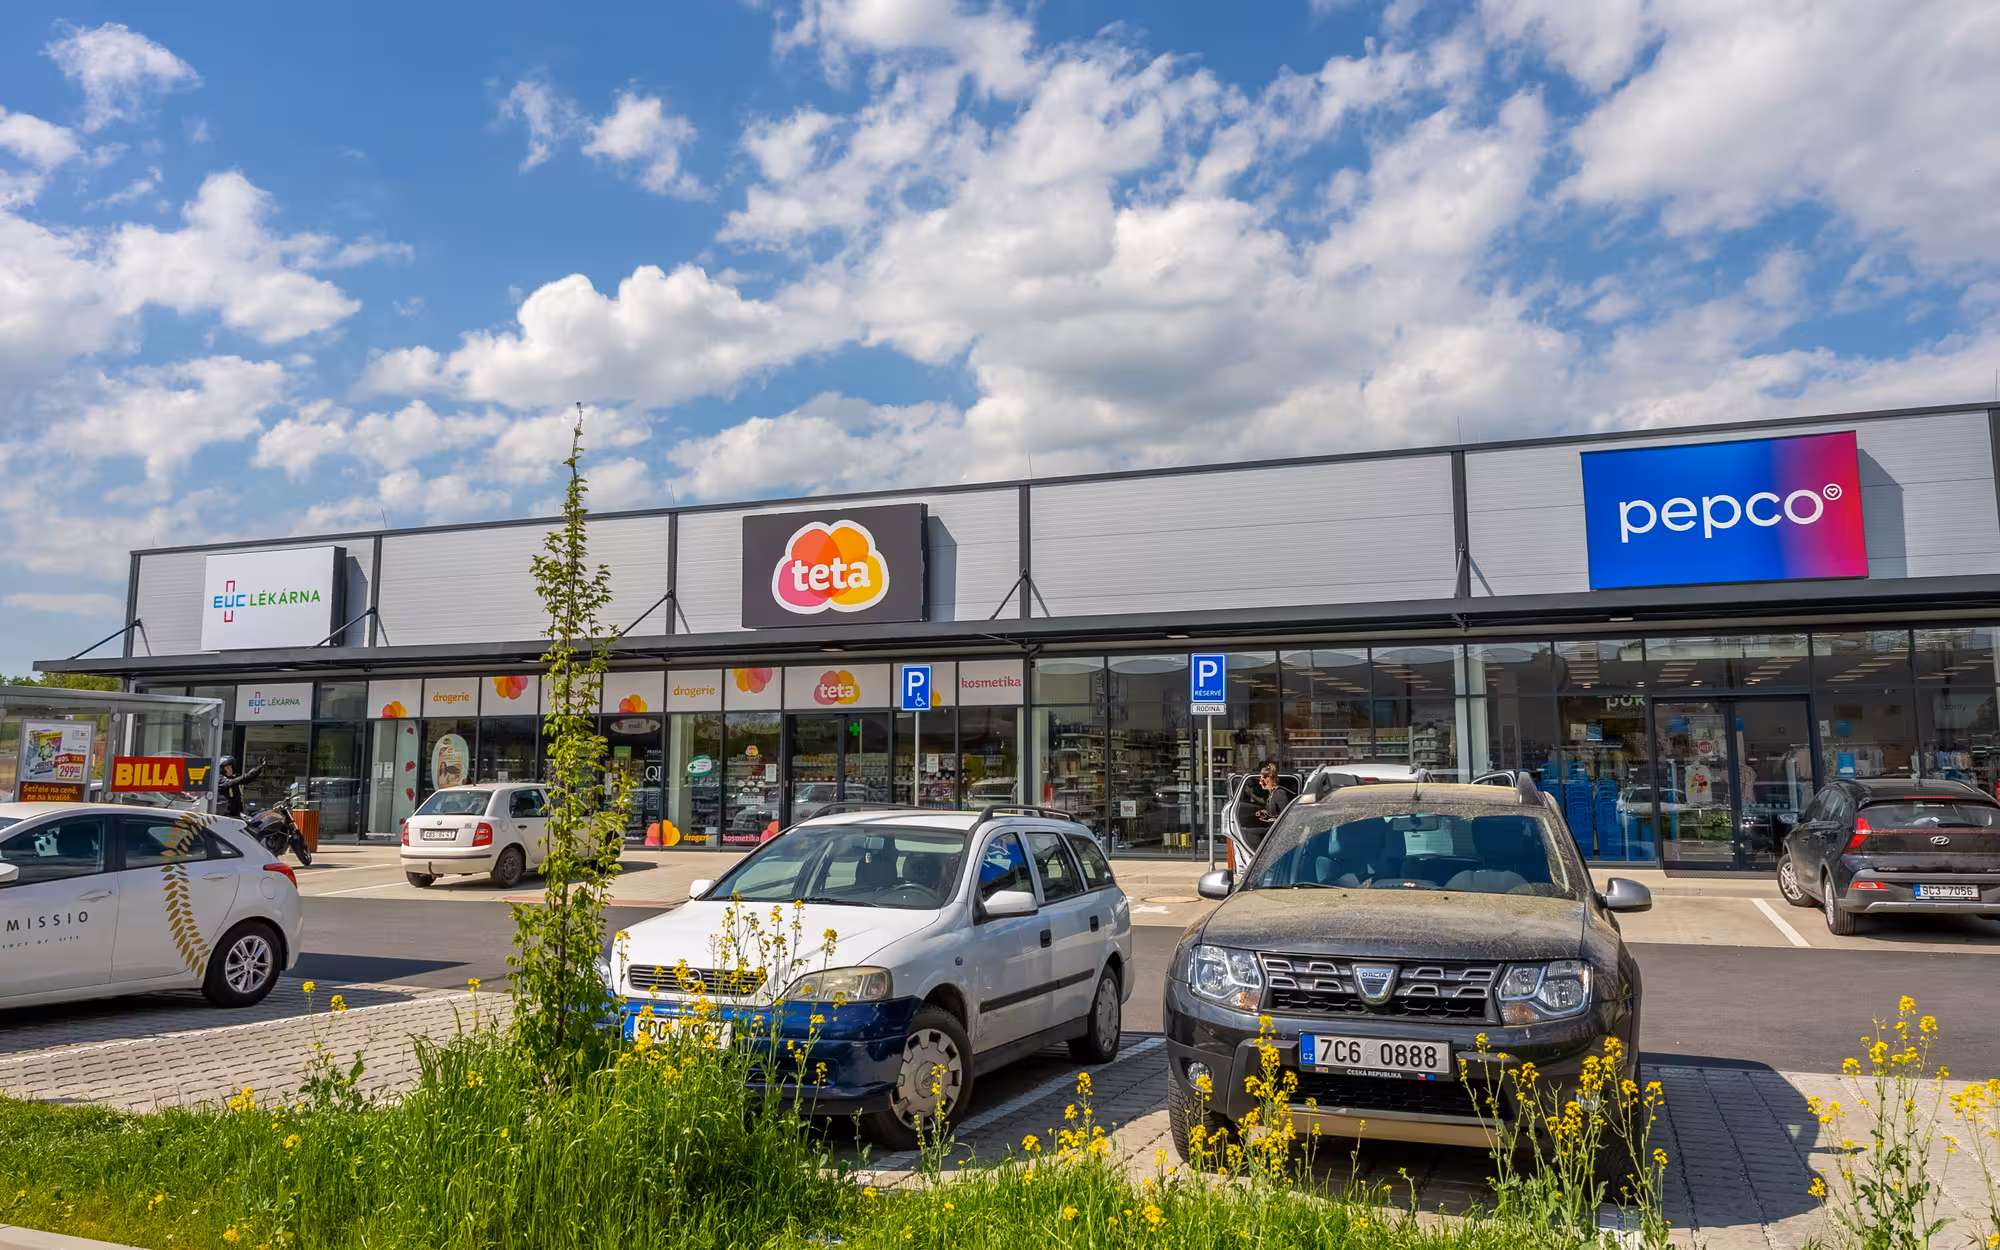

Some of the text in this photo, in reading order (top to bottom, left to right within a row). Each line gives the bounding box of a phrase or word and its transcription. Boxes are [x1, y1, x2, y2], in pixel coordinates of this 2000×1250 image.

[1619, 489, 1824, 543] pepco
[791, 557, 870, 591] teta
[213, 588, 321, 608] EUC LÉKÁRNA
[1199, 660, 1218, 687] P
[907, 671, 924, 696] P
[961, 676, 1021, 689] kosmetika
[432, 691, 469, 705] drogerie
[672, 685, 716, 699] drogerie
[819, 683, 855, 699] teta
[248, 697, 300, 707] EUC LÉKÁRNA
[115, 763, 179, 787] BILLA
[722, 833, 760, 842] kosmetika
[1922, 885, 1973, 896] 9C3 7056
[6, 911, 88, 932] MISSIO
[1303, 1052, 1314, 1061] CZ
[1320, 1039, 1437, 1068] 7C6 0888
[1347, 1069, 1402, 1079] ČESKÁ REPUBLIKA
